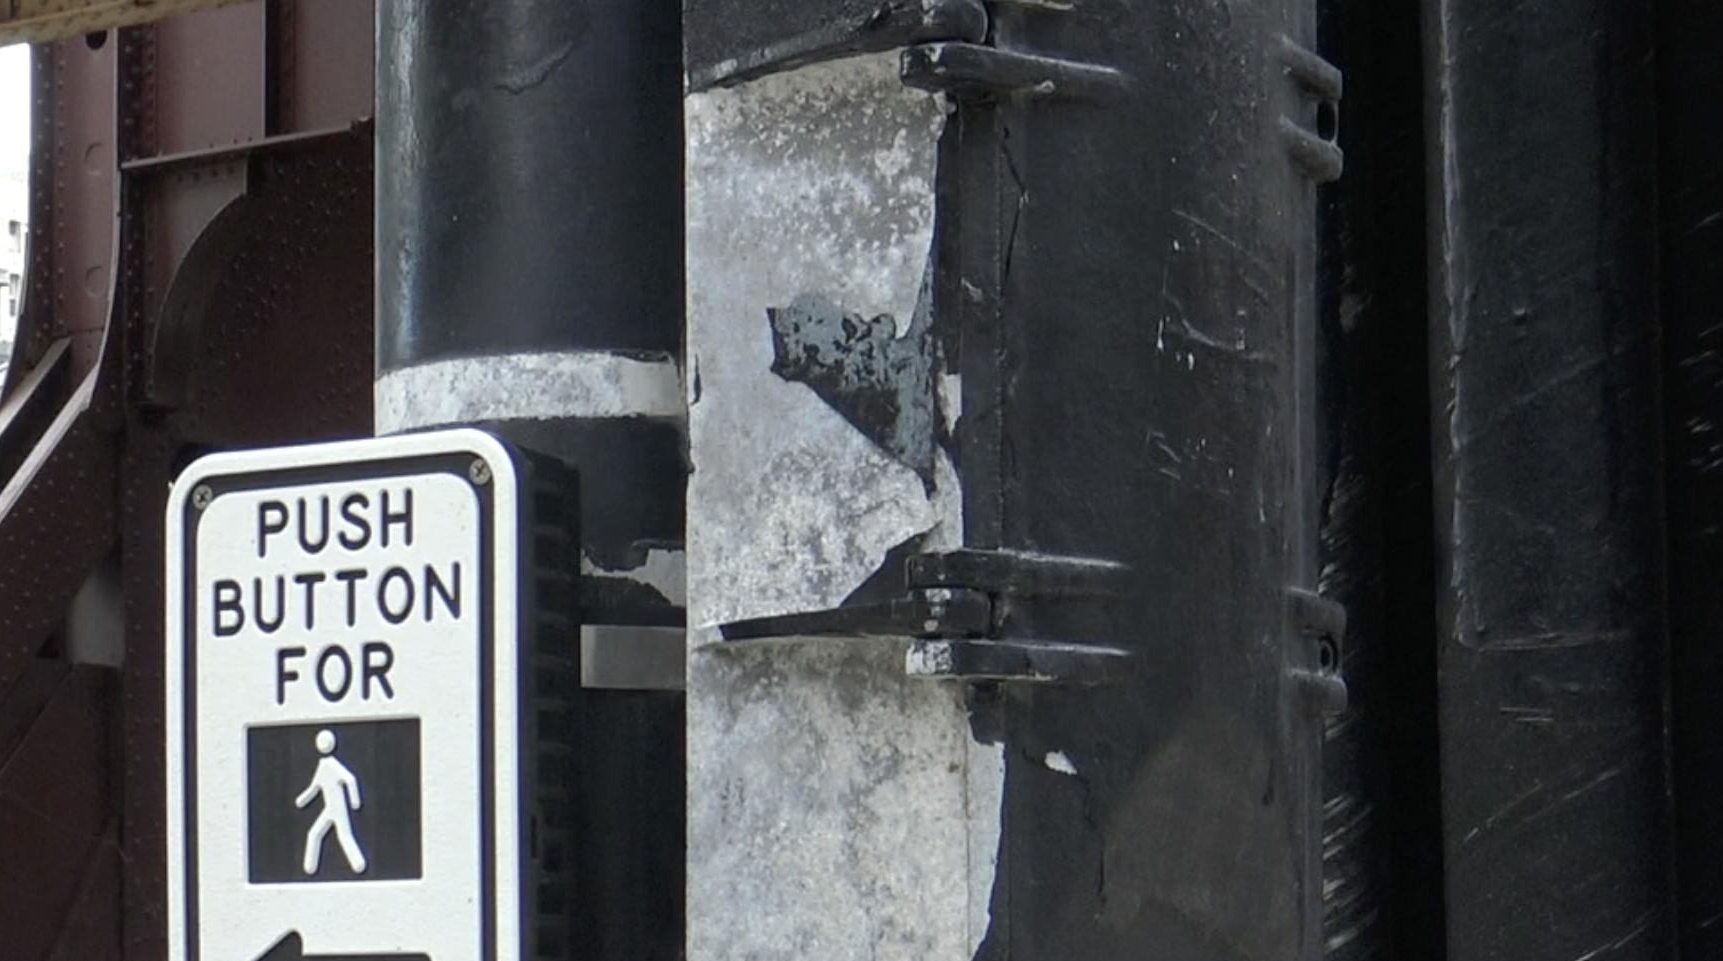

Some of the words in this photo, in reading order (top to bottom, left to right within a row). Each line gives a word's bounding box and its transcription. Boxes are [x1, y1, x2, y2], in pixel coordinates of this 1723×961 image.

[256, 487, 414, 558] PUSH
[212, 561, 462, 638] BUTTON
[275, 641, 396, 706] FOR
